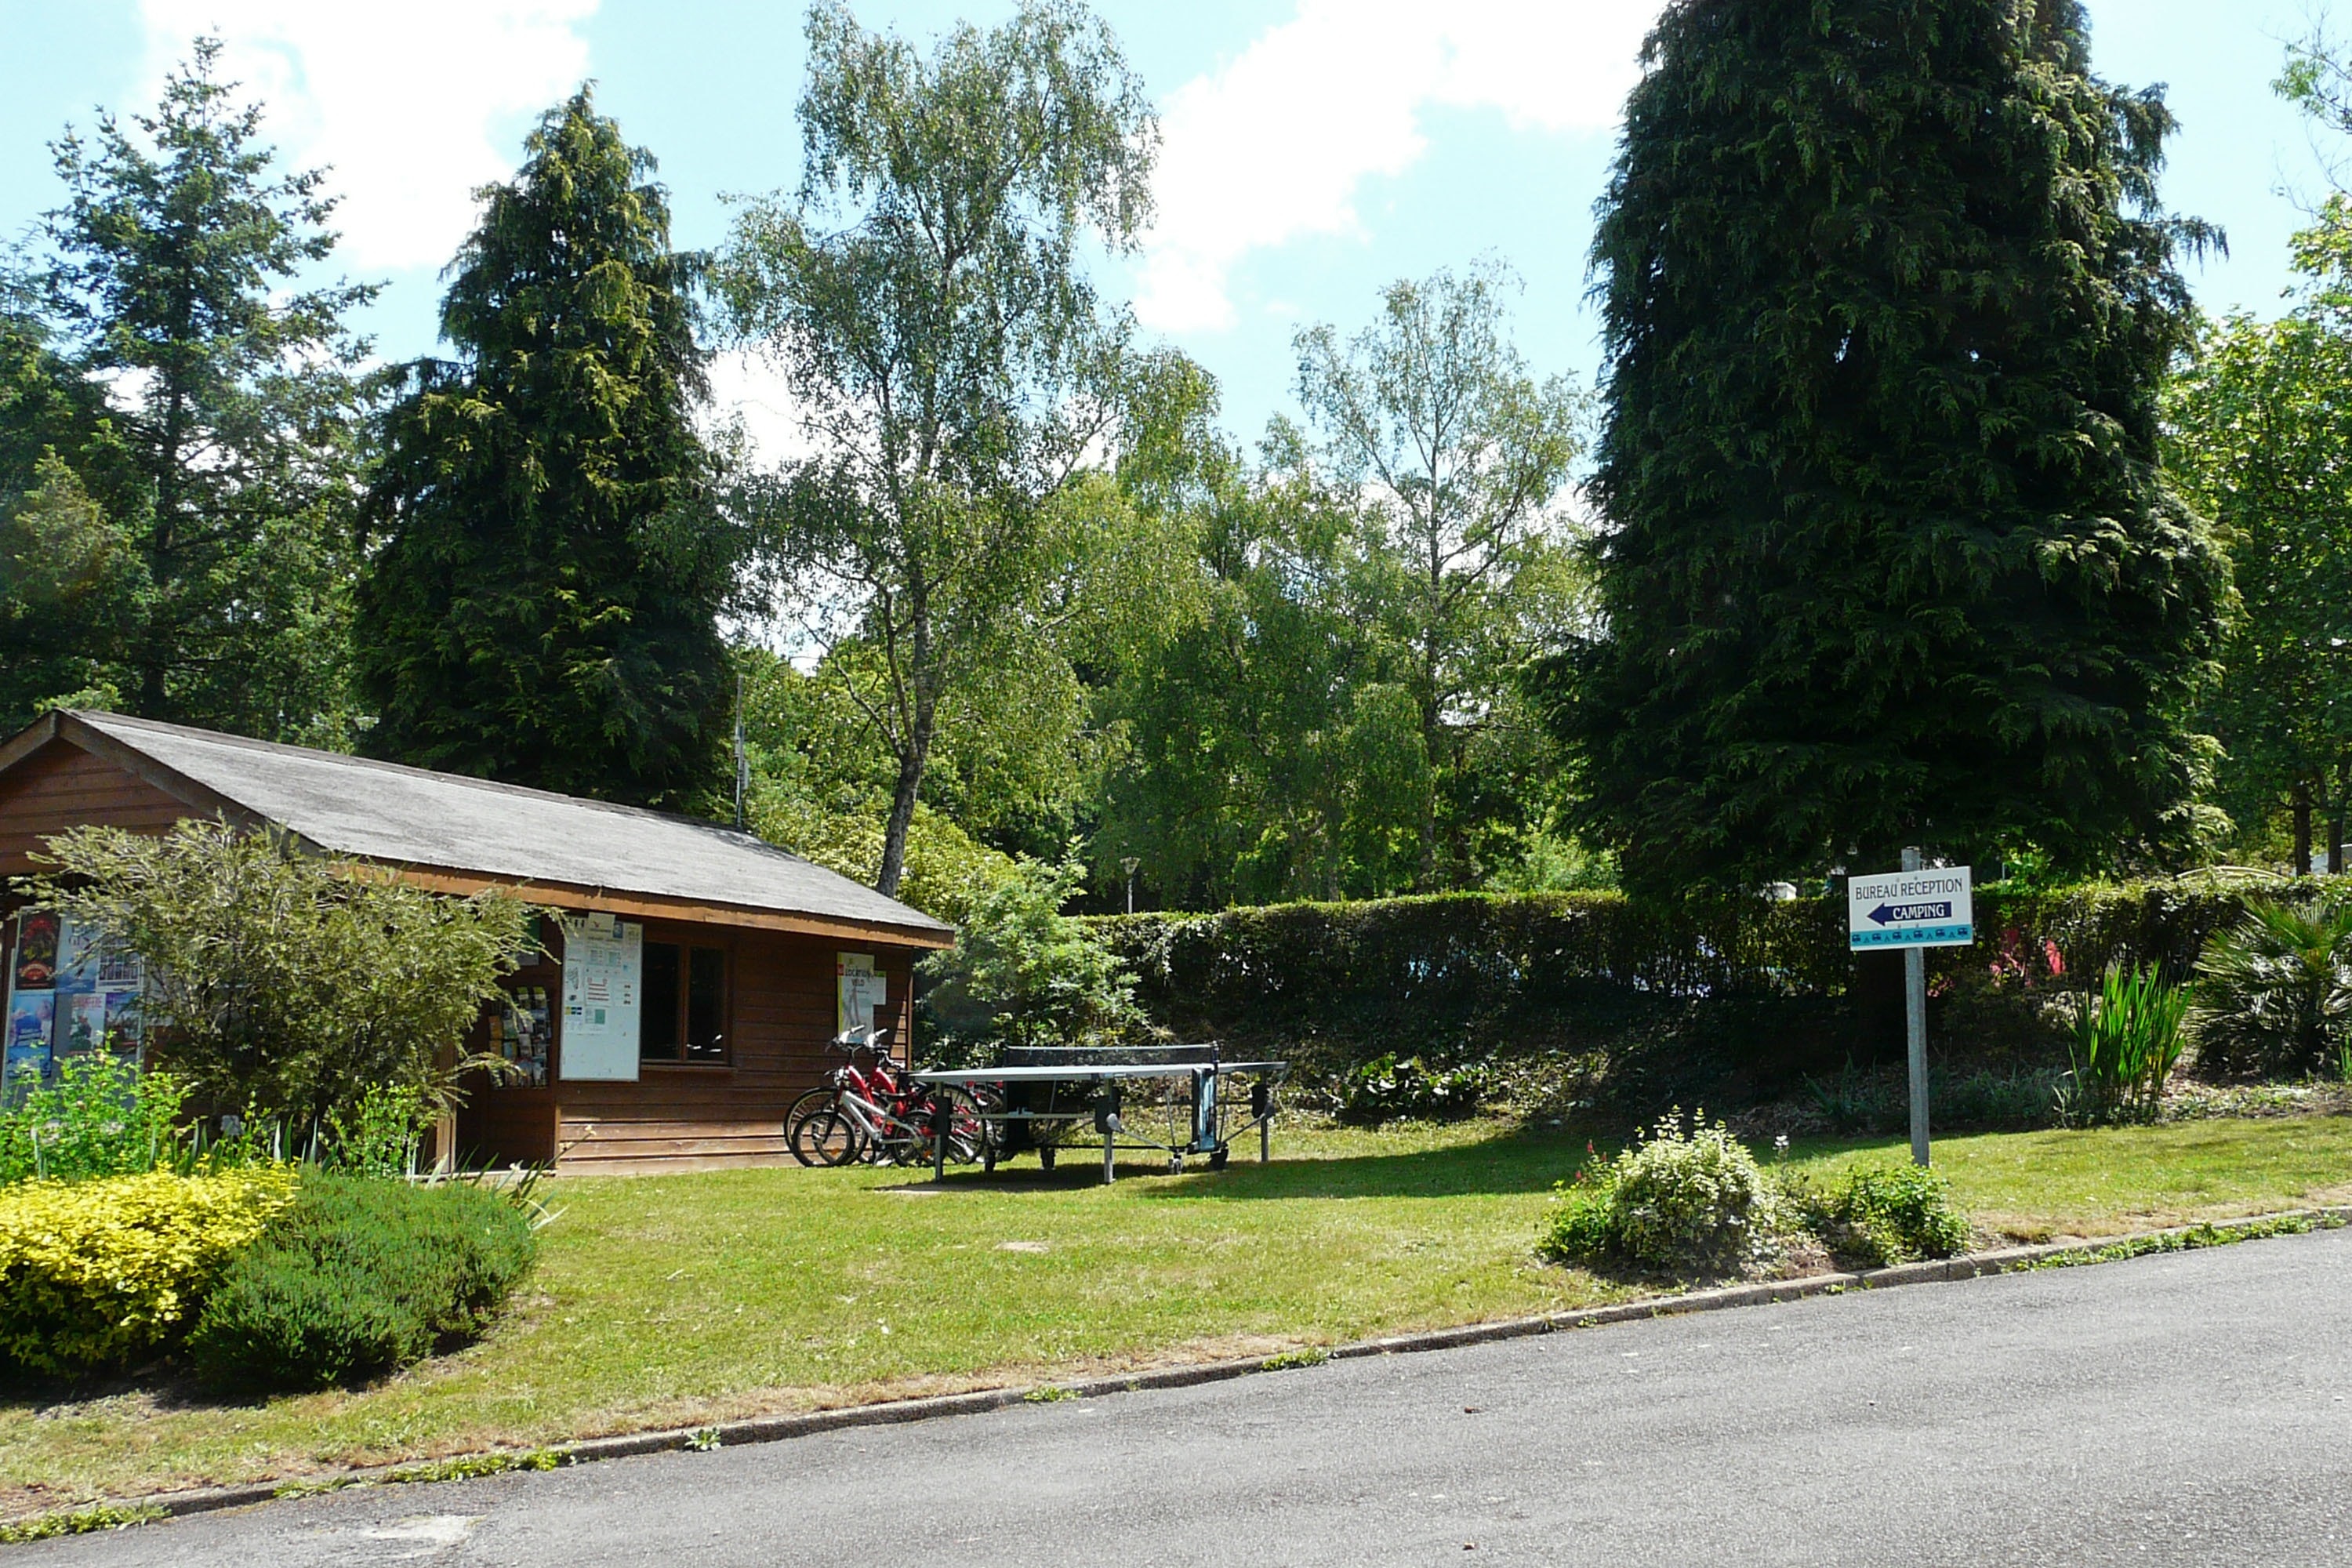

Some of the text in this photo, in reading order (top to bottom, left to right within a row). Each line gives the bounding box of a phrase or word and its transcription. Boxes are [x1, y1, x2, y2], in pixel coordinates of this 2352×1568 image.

[1856, 878, 1962, 900] BUREAU RECEPTION
[1893, 904, 1944, 920] CAMPING
